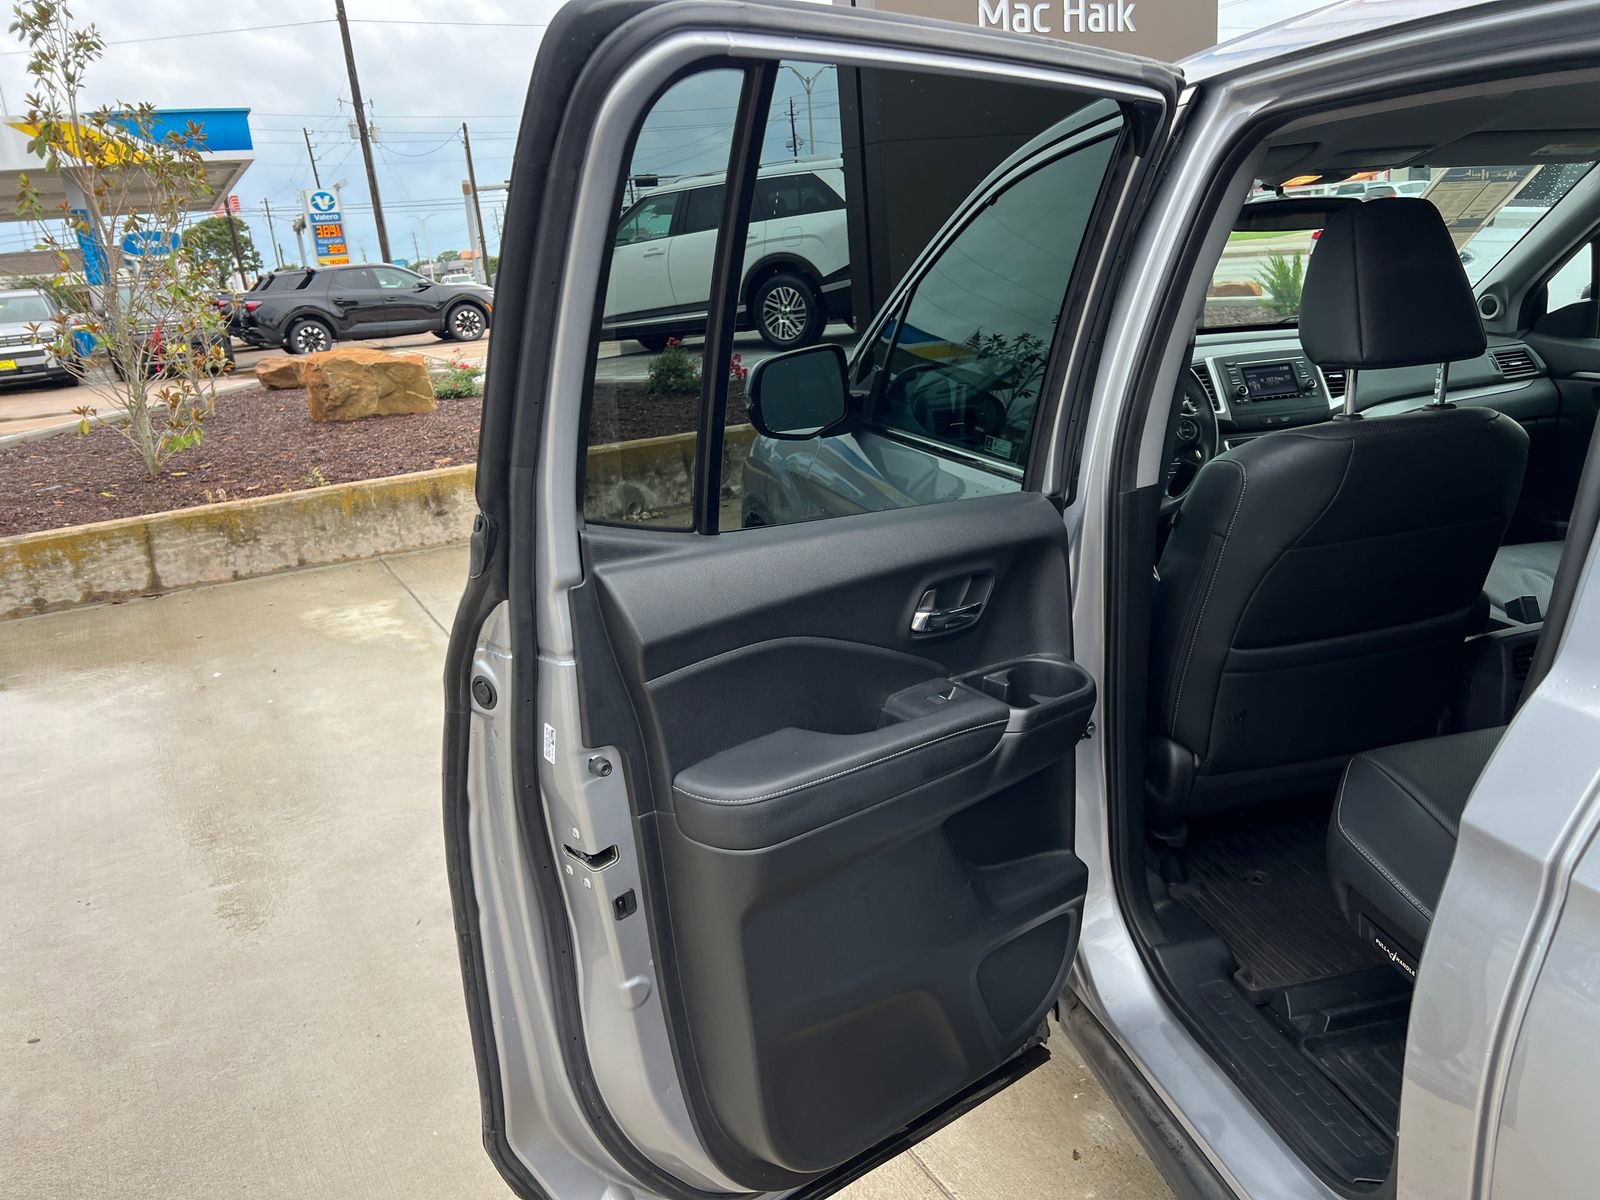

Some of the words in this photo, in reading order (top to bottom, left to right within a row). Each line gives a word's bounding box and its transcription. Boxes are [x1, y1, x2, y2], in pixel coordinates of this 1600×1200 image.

[978, 0, 1051, 33] Mac
[1063, 0, 1138, 33] Haik
[1396, 956, 1416, 977] HANDLE
